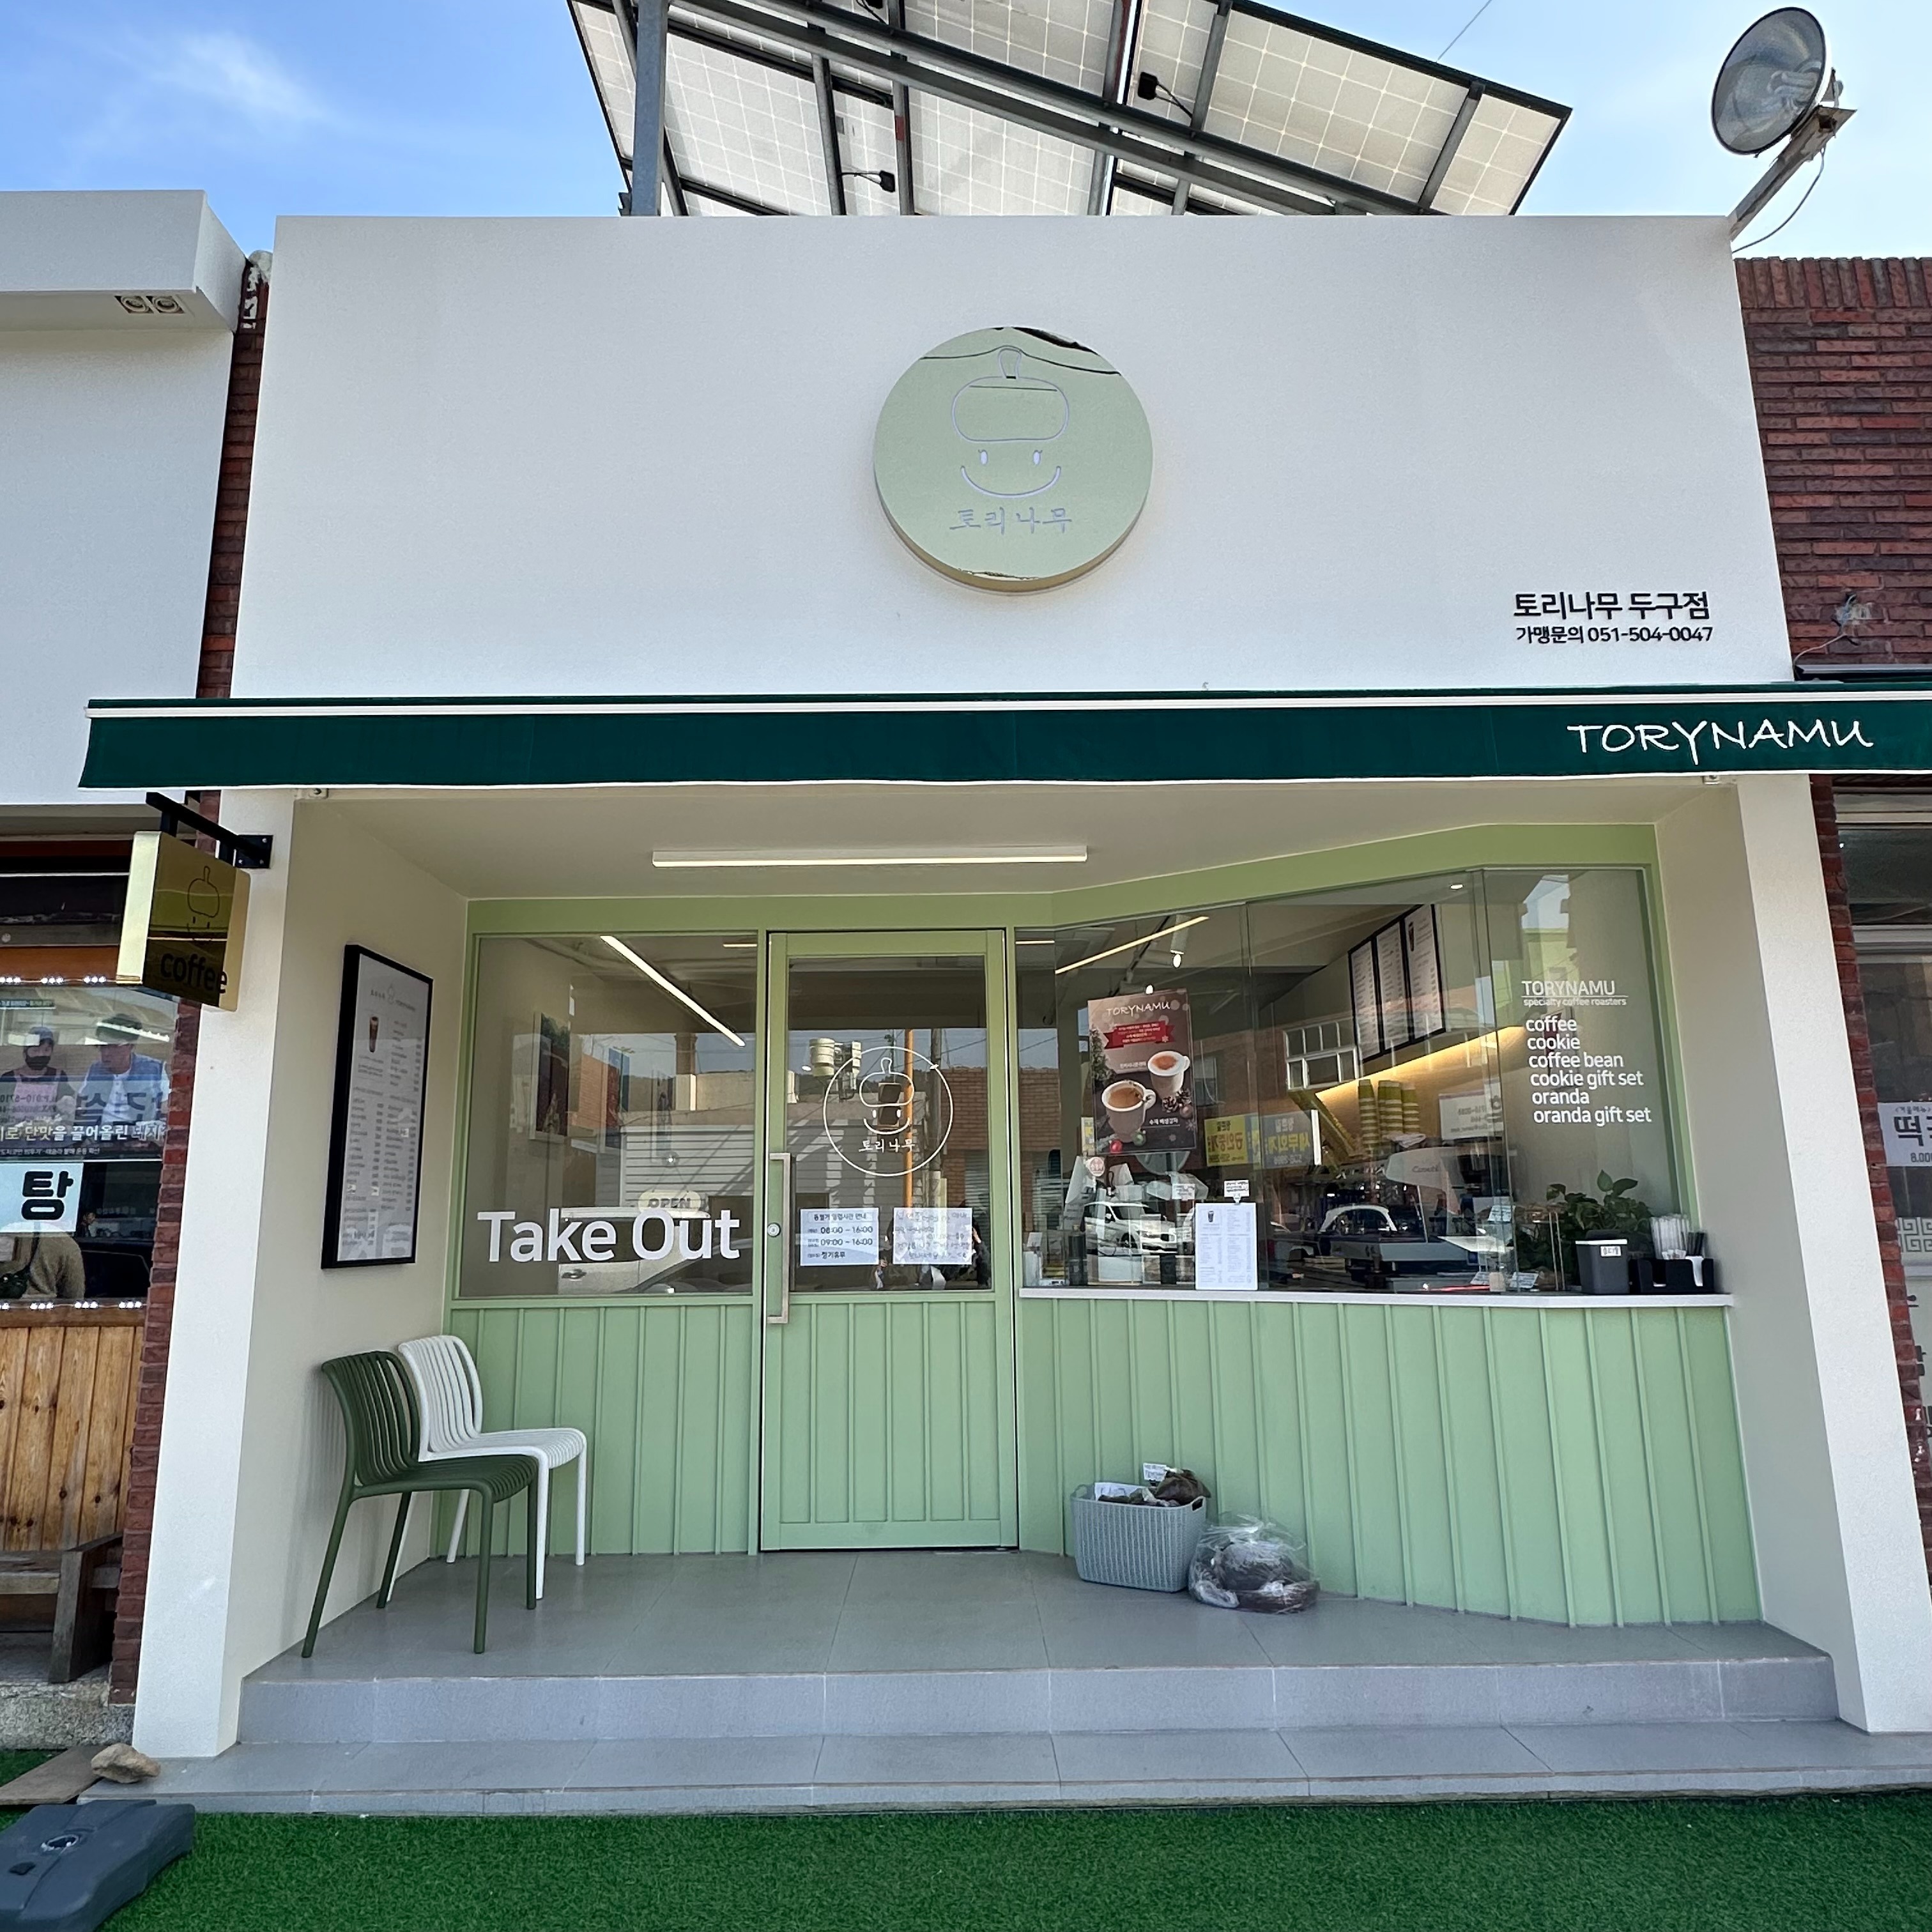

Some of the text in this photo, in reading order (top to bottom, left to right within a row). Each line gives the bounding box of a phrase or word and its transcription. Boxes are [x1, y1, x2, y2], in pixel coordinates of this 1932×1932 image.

[949, 507, 1072, 535] 토리나무
[1512, 591, 1710, 620] 토리나무 두구점
[1516, 625, 1713, 644] 가맹문의 051-504-0047
[1567, 717, 1874, 765] TORYNAMU
[160, 952, 228, 994] coffee
[1521, 980, 1615, 995] TORYNAMU
[1107, 1002, 1170, 1017] TORYNAMU
[1523, 998, 1561, 1008] specialty
[1526, 1015, 1577, 1032] coffee
[1527, 1034, 1581, 1050] cookie
[1528, 1052, 1624, 1068] coffee bean
[1530, 1070, 1644, 1090] cookie gift set
[1532, 1088, 1590, 1105] oranda
[1534, 1106, 1652, 1126] oranda gift set
[24, 1124, 67, 1141] 단맛을
[70, 1124, 128, 1141] 끌어올린
[858, 1138, 916, 1154] 토리나무
[1910, 1153, 1932, 1163] 8.00
[21, 1170, 74, 1220] 탕
[647, 1198, 691, 1208] OPEN
[477, 1208, 740, 1262] Take Out
